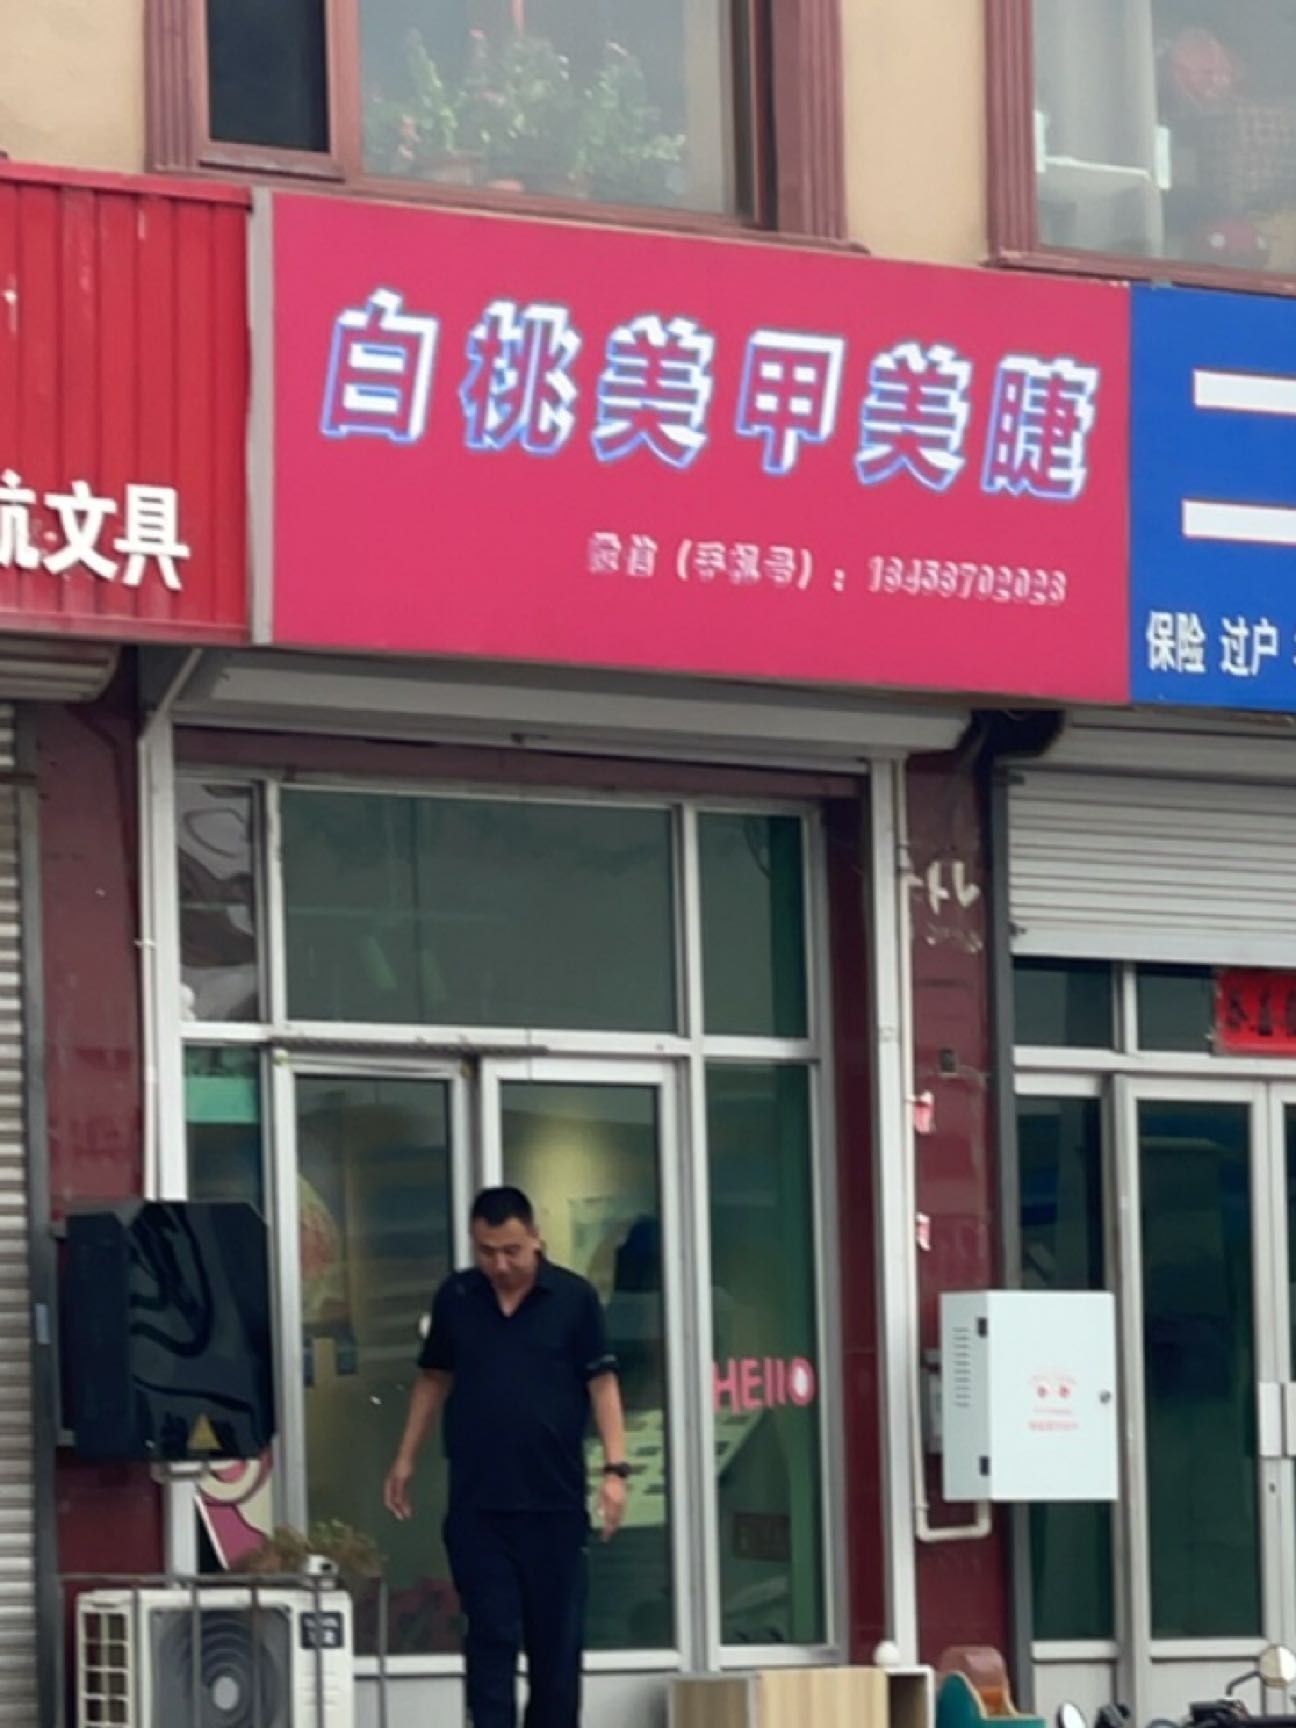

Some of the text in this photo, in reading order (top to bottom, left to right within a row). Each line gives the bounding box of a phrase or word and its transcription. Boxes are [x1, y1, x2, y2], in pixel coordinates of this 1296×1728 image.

[320, 286, 1099, 502] 白桃美甲美睫
[1146, 611, 1206, 673] 保险
[1220, 616, 1279, 678] 过户
